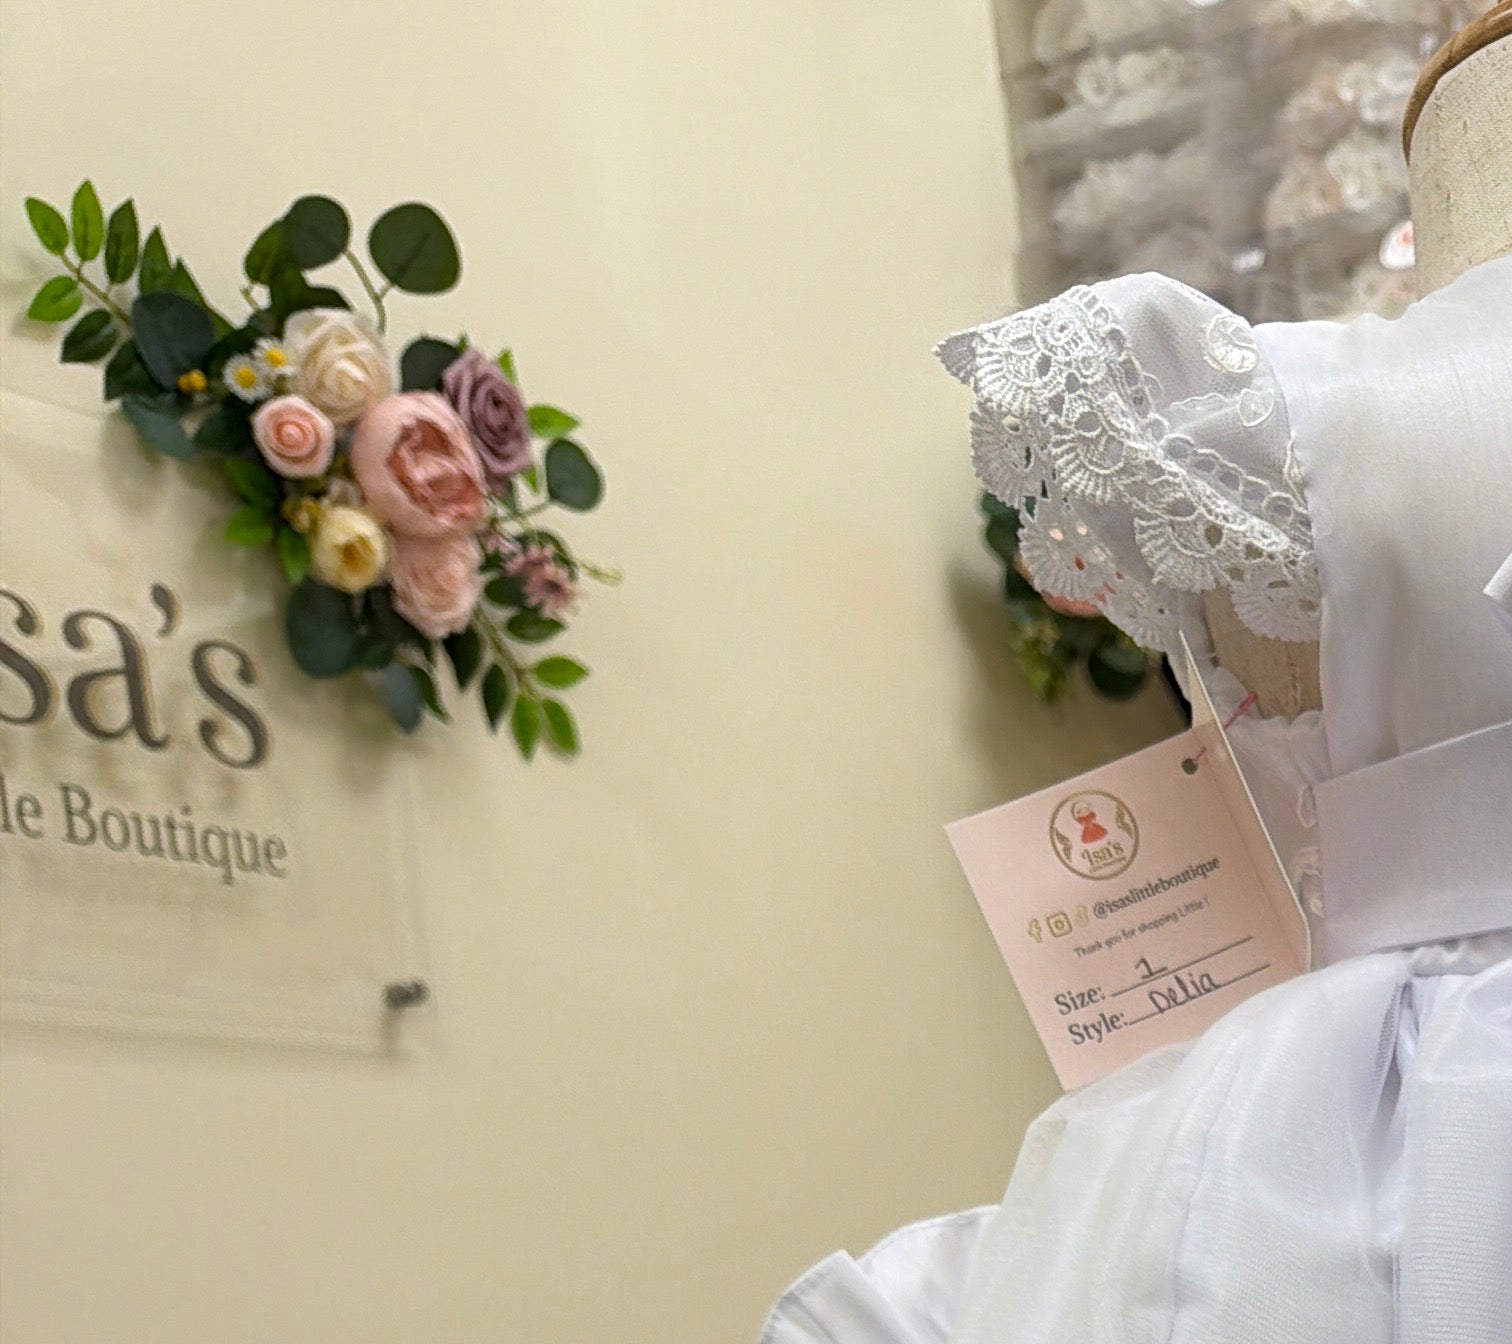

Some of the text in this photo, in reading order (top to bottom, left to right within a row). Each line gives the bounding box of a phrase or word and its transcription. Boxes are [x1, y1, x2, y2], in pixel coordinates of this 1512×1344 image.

[60, 781, 288, 887] Boutique
[1081, 841, 1124, 867] Isa's
[1093, 856, 1221, 919] @isaslittleboutique
[1073, 940, 1103, 958] Thank
[1104, 935, 1122, 949] you
[1121, 927, 1136, 939] for
[1135, 957, 1168, 980] 1
[1054, 986, 1106, 1016] Size:
[1148, 972, 1222, 1013] Delia
[1068, 1012, 1128, 1045] Style:
